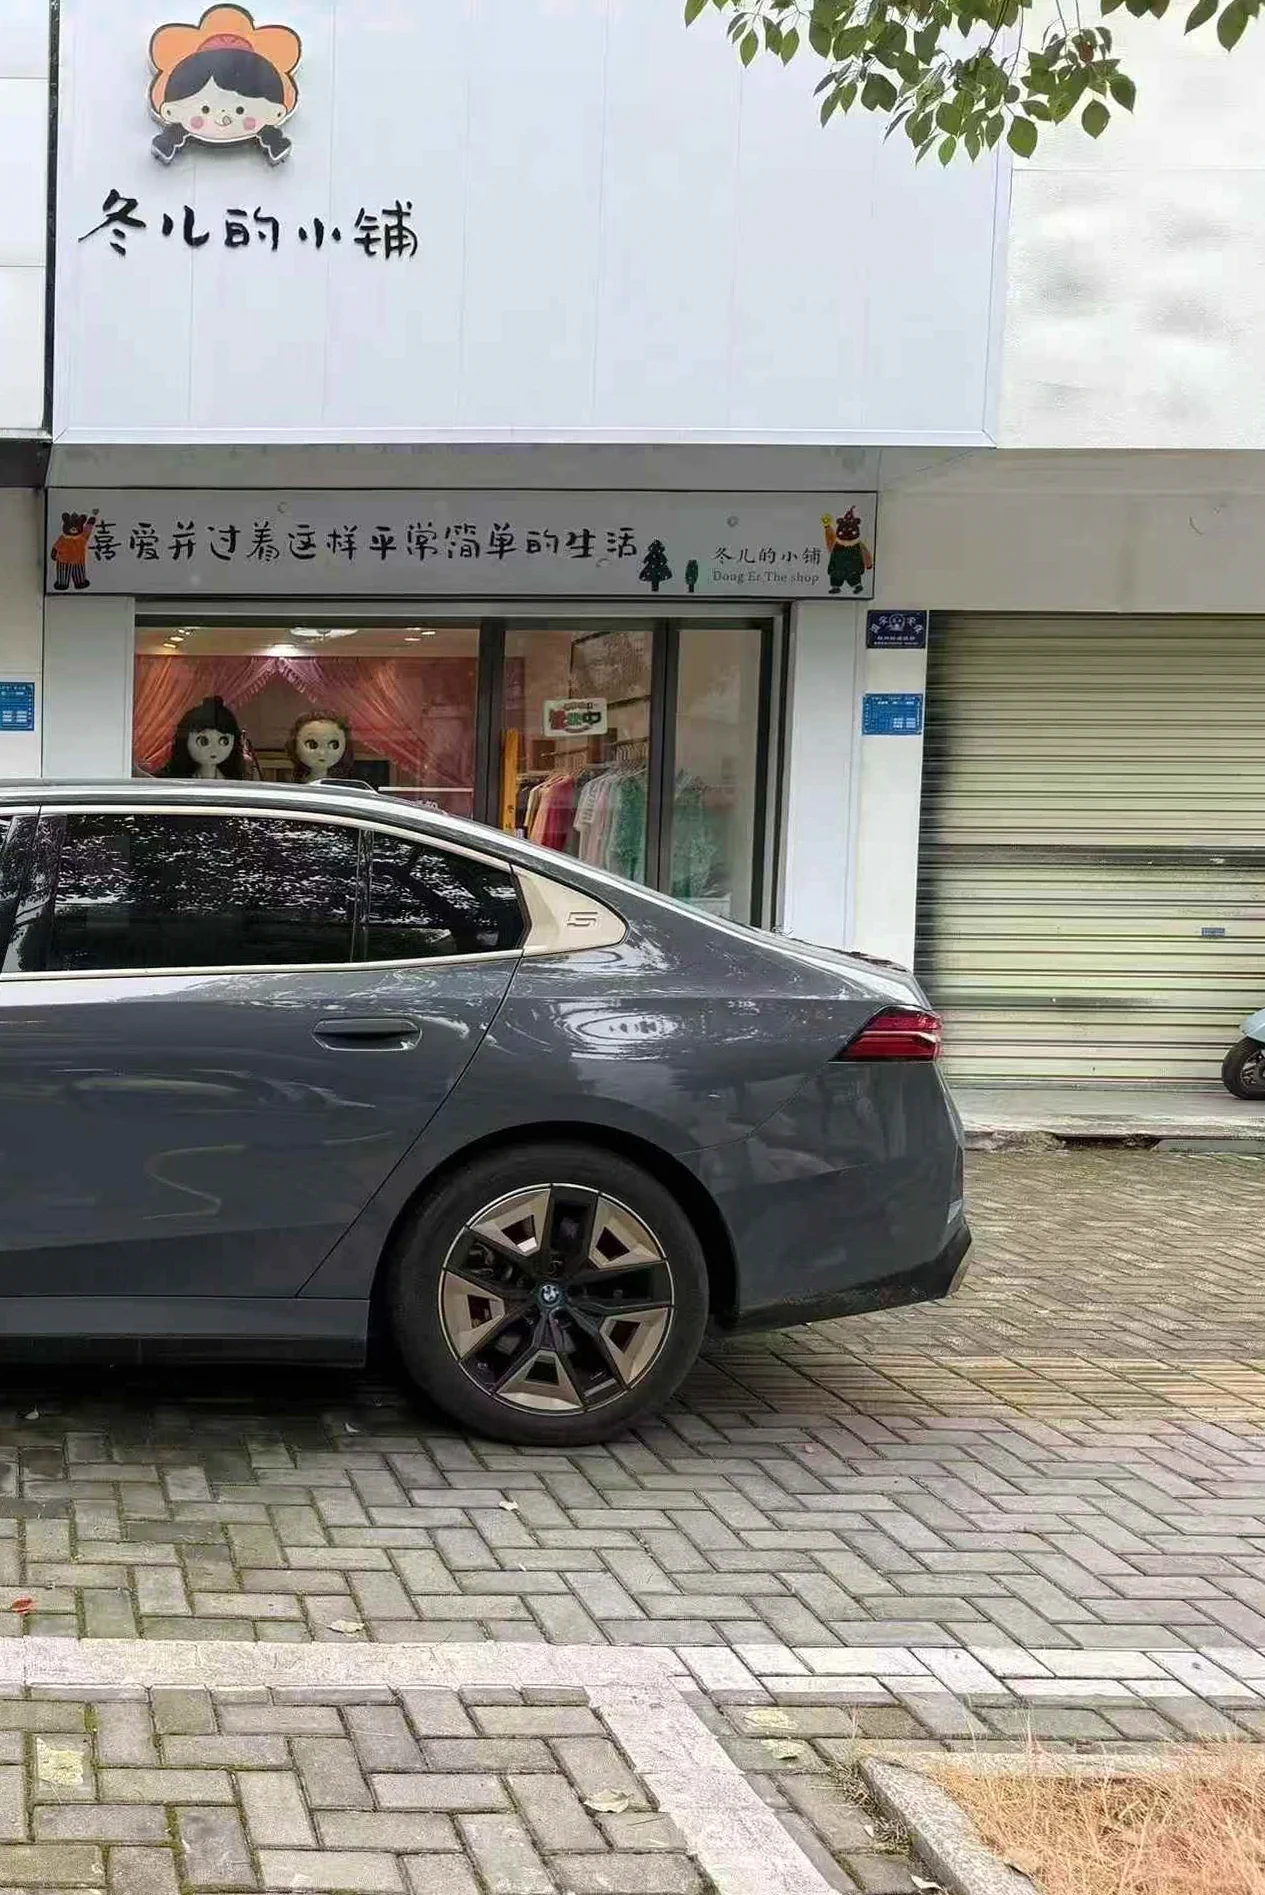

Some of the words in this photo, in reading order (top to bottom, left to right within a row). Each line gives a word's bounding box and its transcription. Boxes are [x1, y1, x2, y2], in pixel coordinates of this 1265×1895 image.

[77, 188, 418, 259] 冬儿的小铺
[88, 519, 637, 563] 喜爱并过着这样平常简单的生活
[712, 546, 822, 565] 冬儿的小铺
[713, 571, 744, 585] Dong
[764, 571, 787, 582] The
[790, 571, 820, 586] shop
